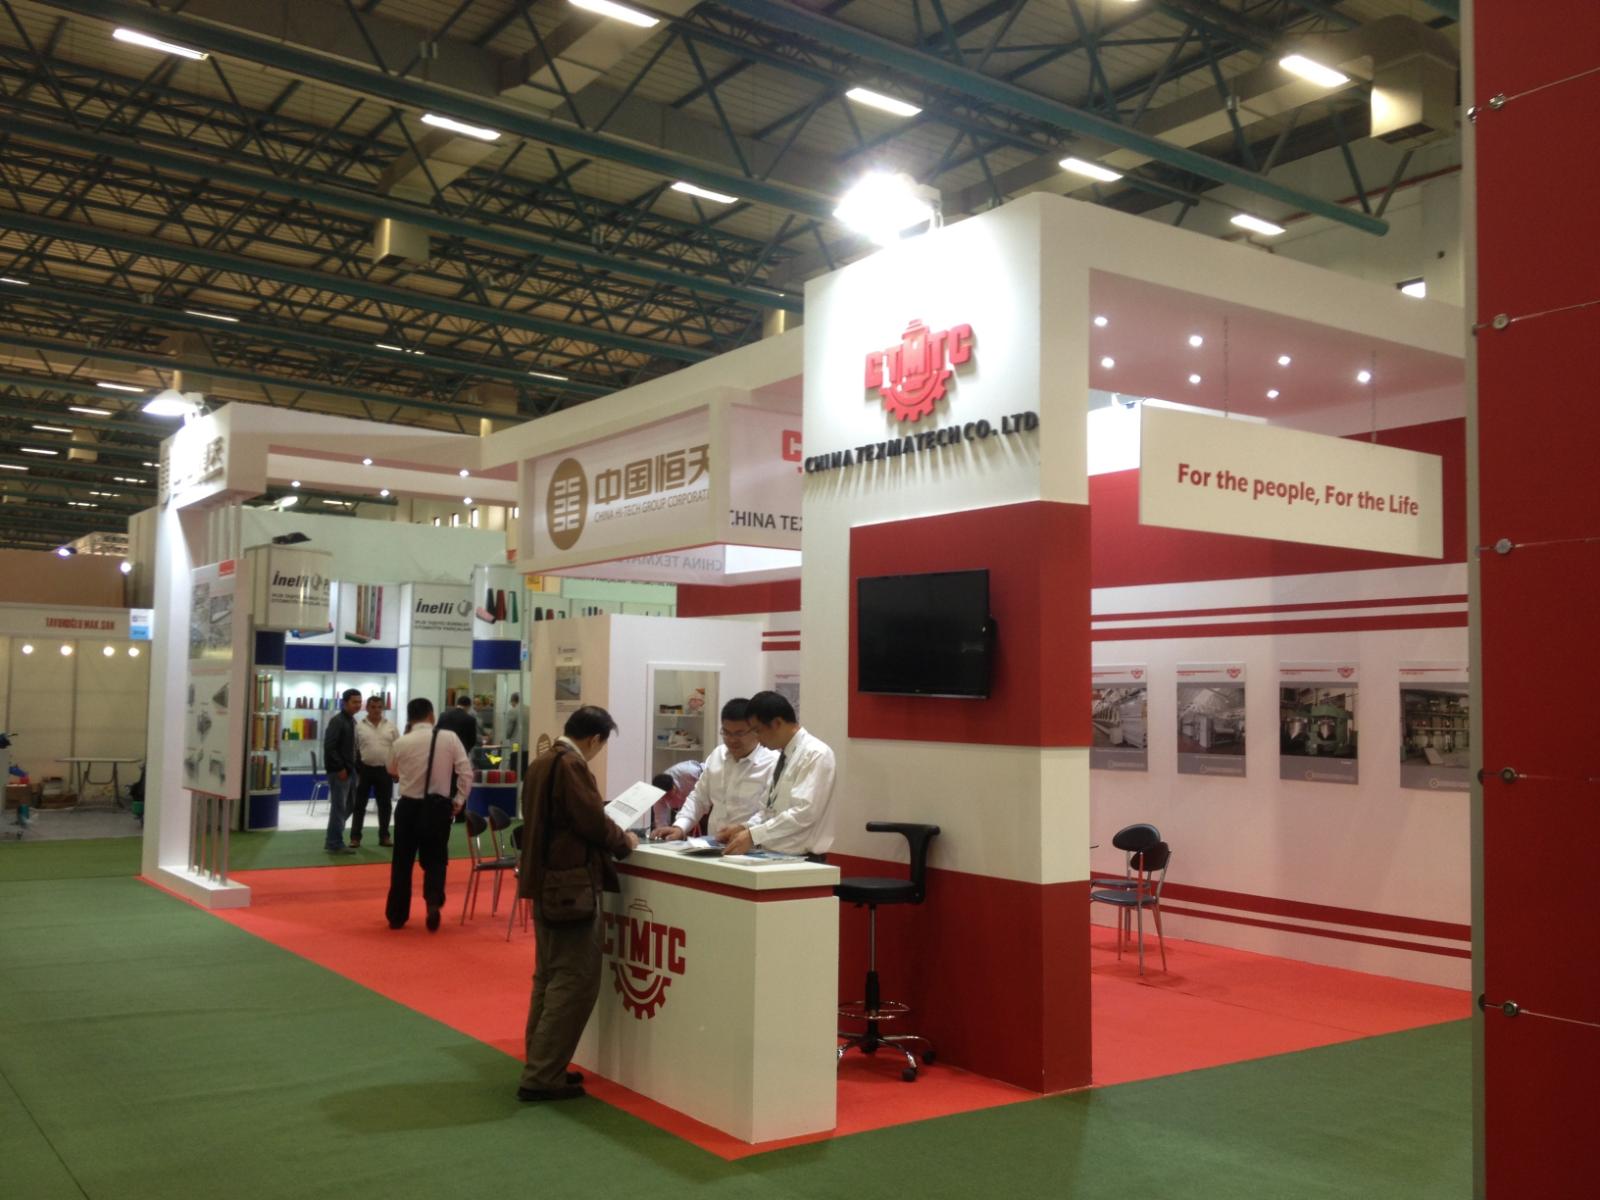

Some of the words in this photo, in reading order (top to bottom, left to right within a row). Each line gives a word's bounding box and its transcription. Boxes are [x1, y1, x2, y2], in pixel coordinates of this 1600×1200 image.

[864, 323, 973, 390] CTMTC
[804, 449, 855, 474] CHINA
[855, 425, 961, 464] TEXMATECH
[1001, 411, 1039, 435] LTD
[594, 444, 710, 505] 中国恒天
[1177, 463, 1212, 487] For
[1216, 470, 1249, 493] the
[1253, 478, 1320, 506] people,
[1325, 485, 1354, 507] For
[1357, 491, 1385, 512] the
[1389, 494, 1419, 516] Life
[602, 911, 686, 976] CTMTC
